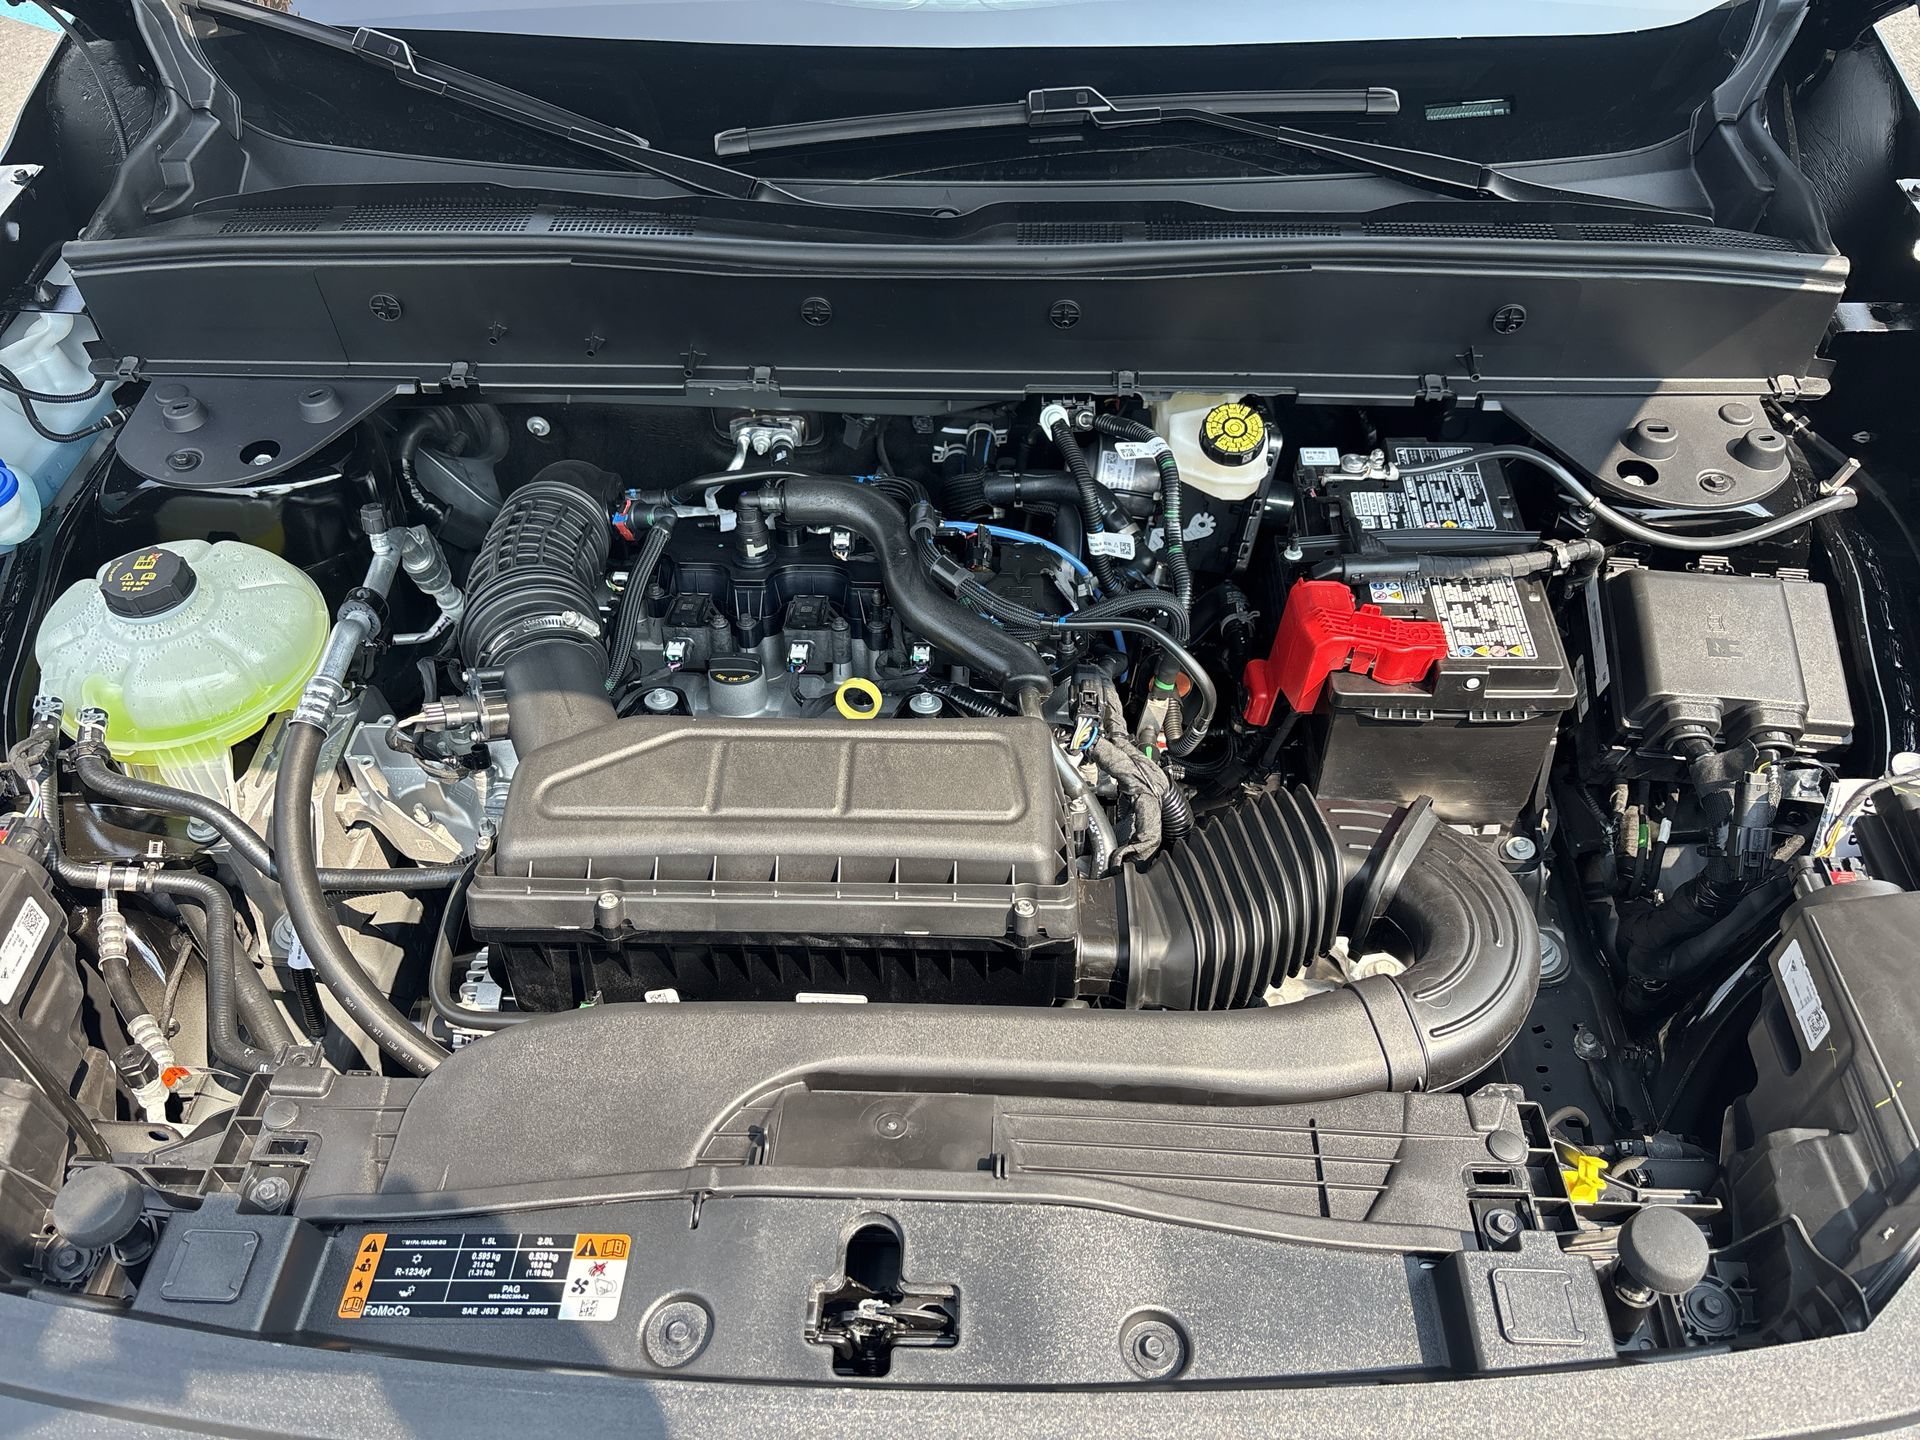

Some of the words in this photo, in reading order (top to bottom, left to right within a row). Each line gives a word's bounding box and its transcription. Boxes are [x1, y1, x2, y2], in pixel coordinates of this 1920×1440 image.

[387, 1040, 399, 1051] PET
[491, 1252, 501, 1261] kg
[548, 1252, 559, 1262] kg
[395, 1267, 432, 1277] R-1234yf
[501, 1285, 520, 1293] PAG
[363, 1305, 410, 1316] FoMoCo
[461, 1306, 478, 1315] SAE
[480, 1307, 498, 1315] J639
